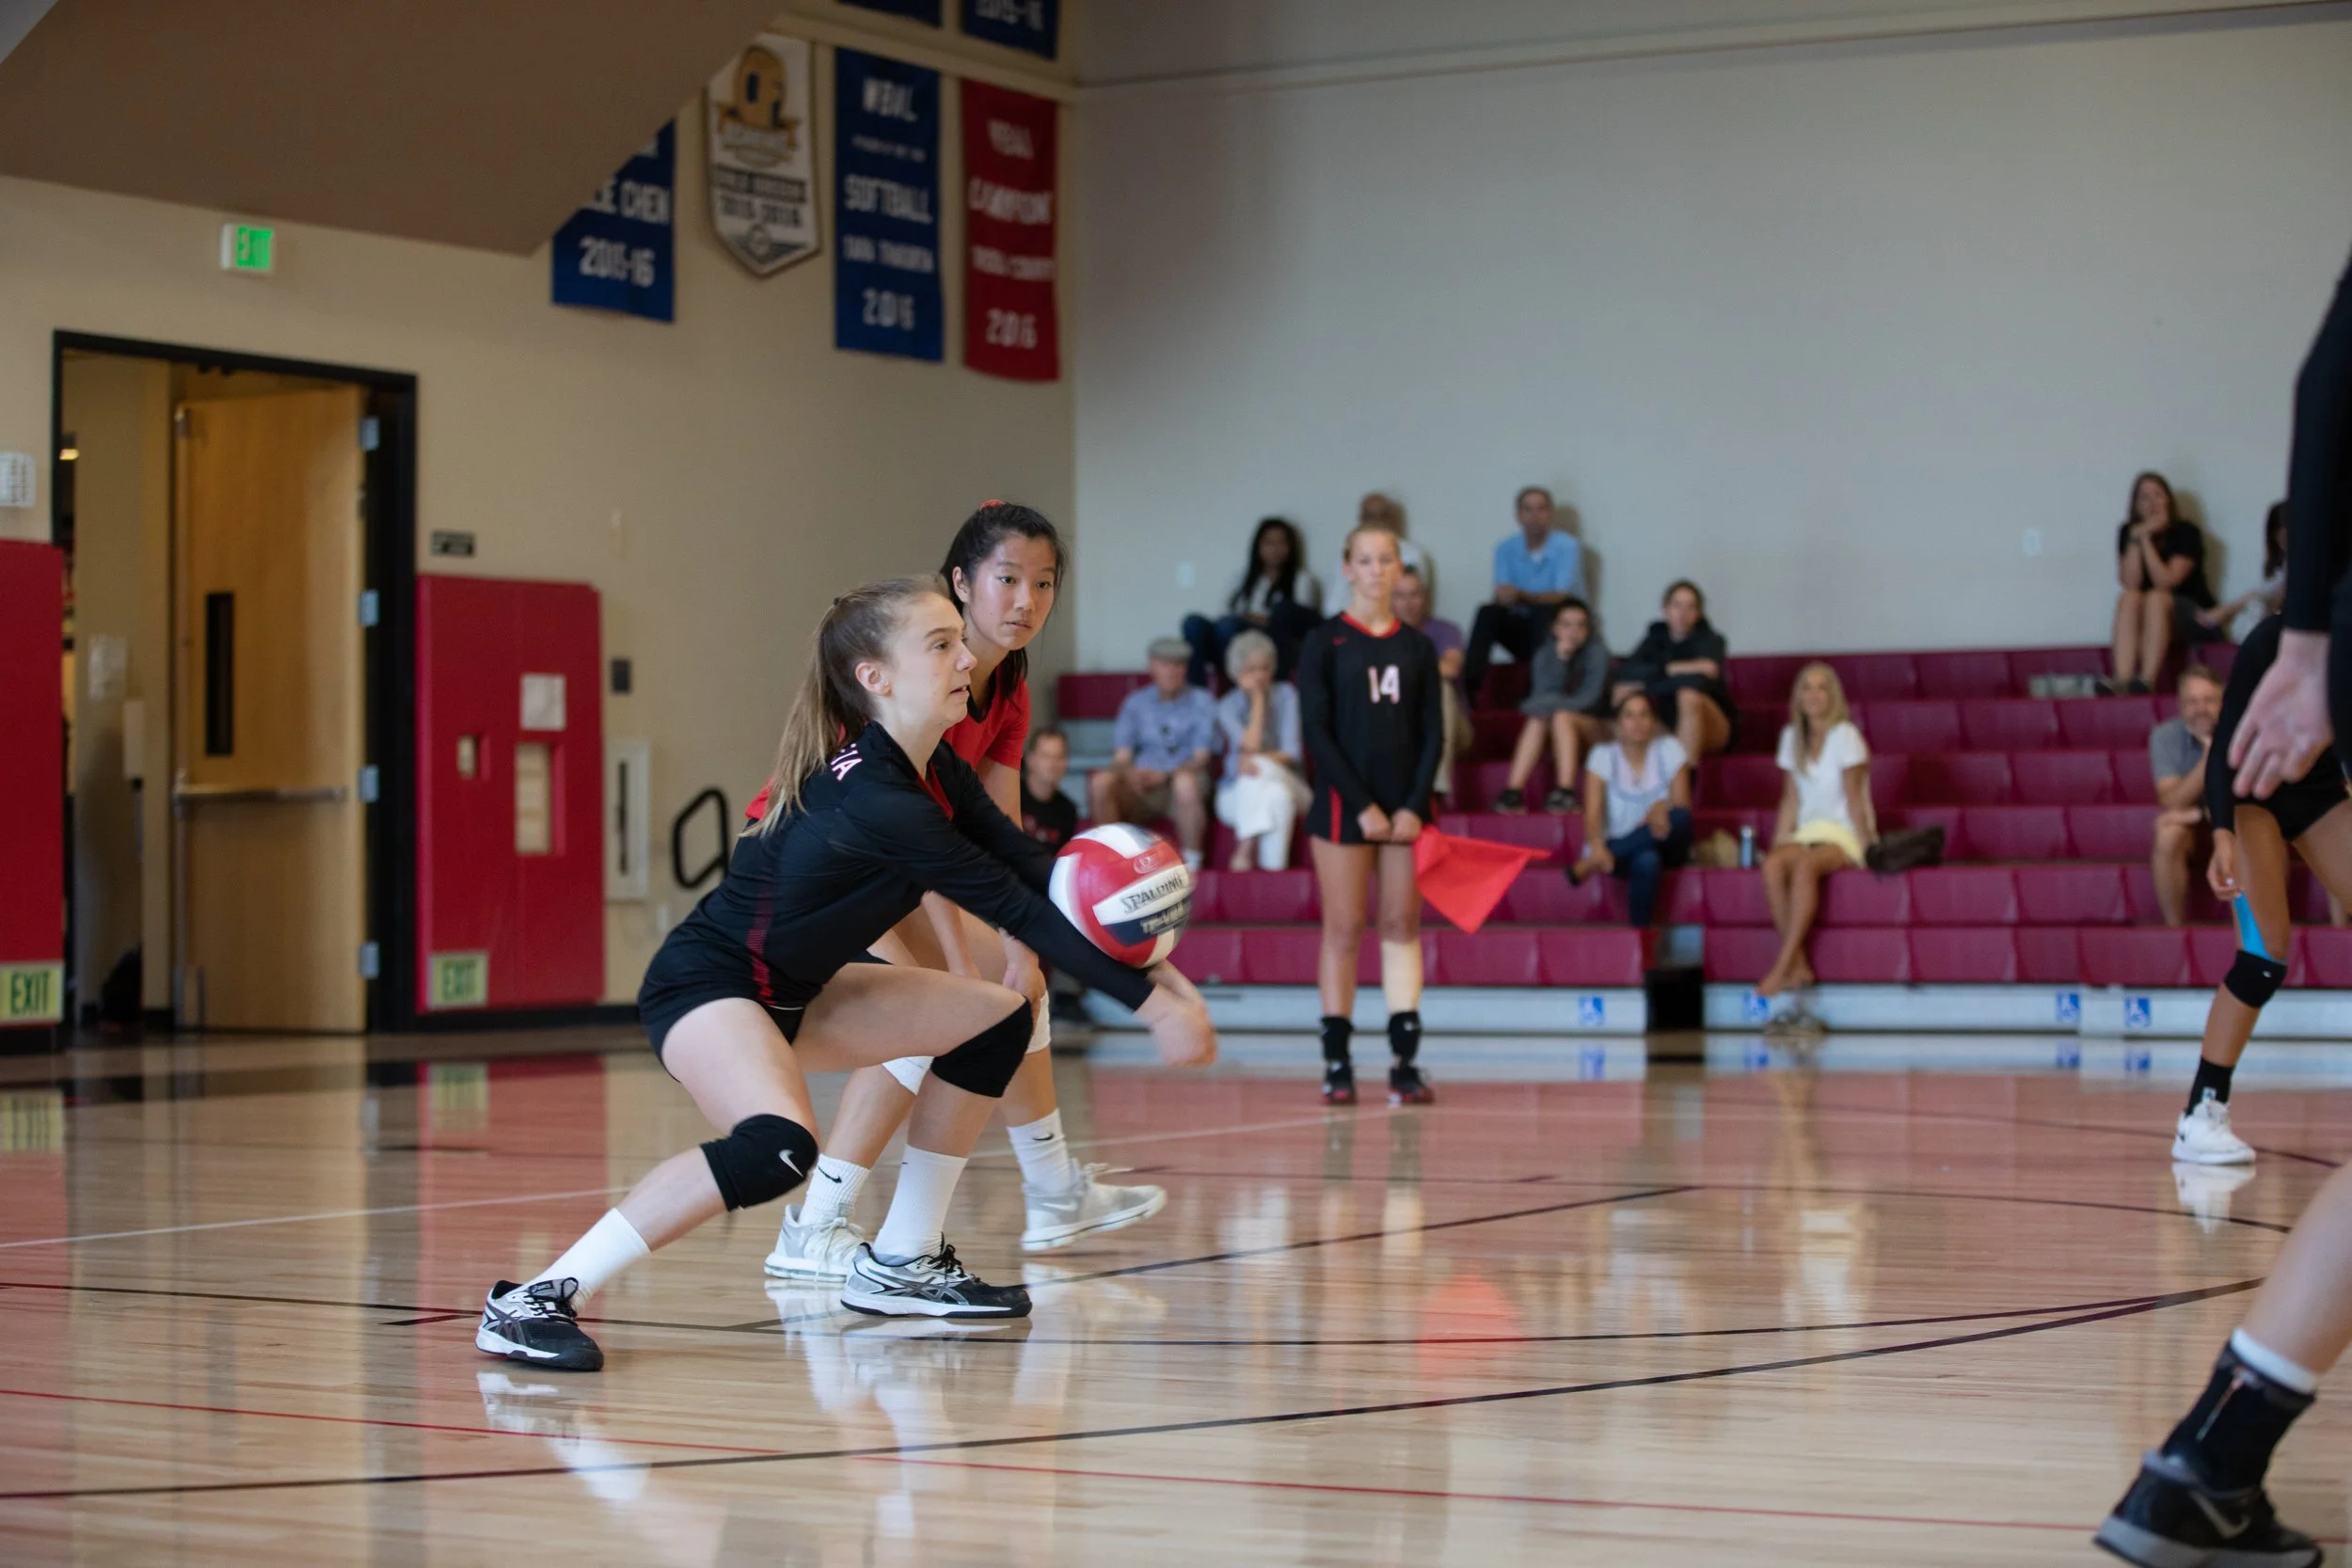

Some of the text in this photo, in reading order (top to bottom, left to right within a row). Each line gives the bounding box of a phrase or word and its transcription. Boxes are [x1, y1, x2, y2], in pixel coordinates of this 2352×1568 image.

[620, 180, 669, 226] CHEN
[843, 173, 933, 225] SOFTBALL
[1368, 665, 1402, 705] 14
[1120, 872, 1184, 914] SPALDING
[10, 972, 51, 1015] EXIT
[440, 959, 478, 1000] EXIT
